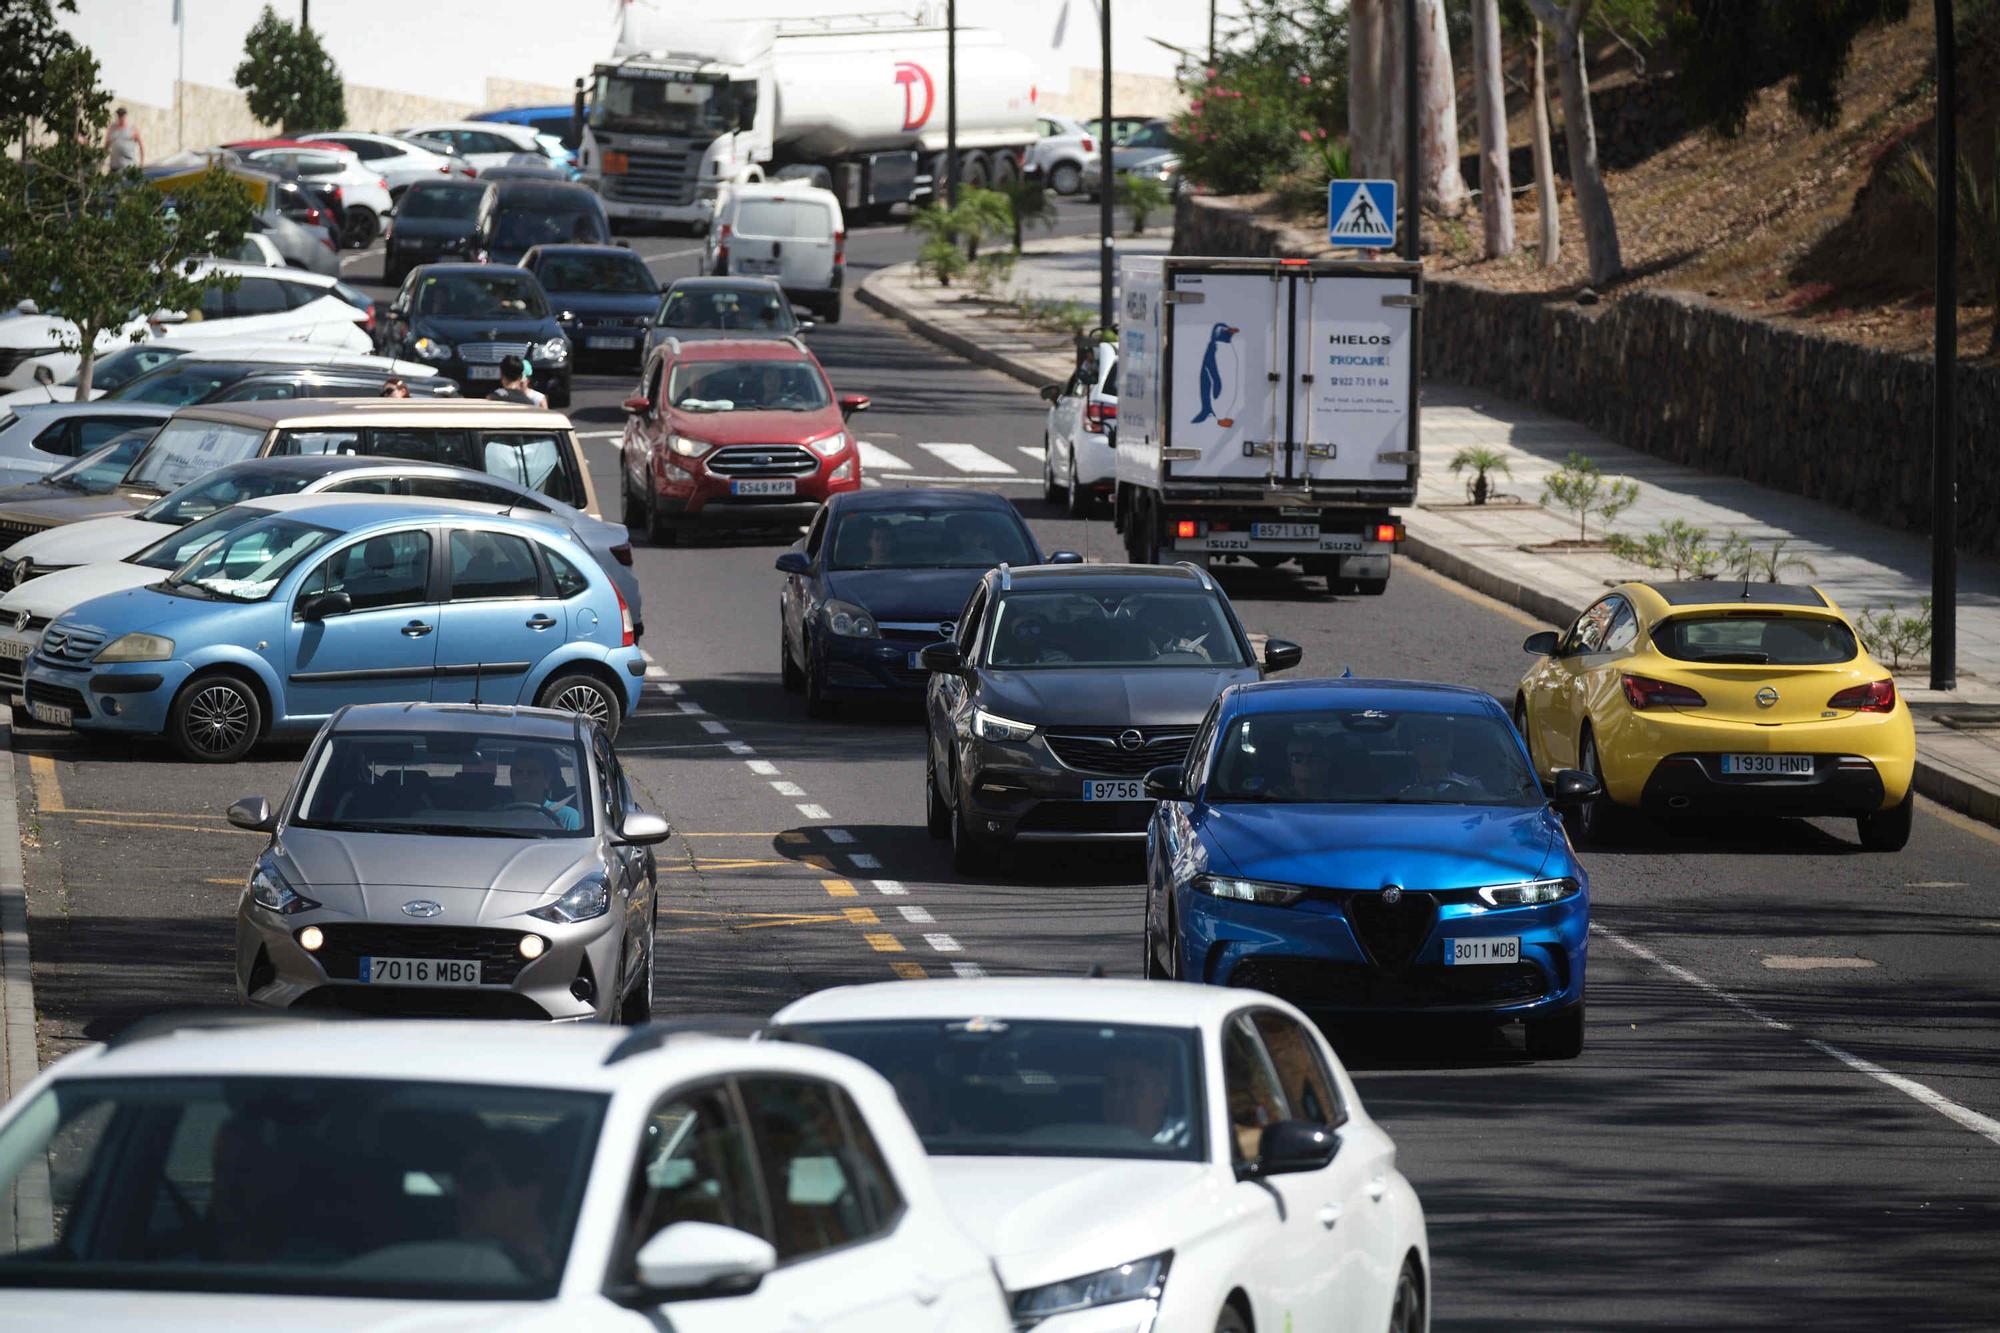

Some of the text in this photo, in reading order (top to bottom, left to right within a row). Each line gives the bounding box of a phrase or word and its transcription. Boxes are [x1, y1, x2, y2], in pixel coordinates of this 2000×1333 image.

[1329, 335, 1391, 345] HIELOS
[1260, 524, 1316, 537] 8571 LXT
[1206, 540, 1249, 549] ISUZU
[1319, 541, 1363, 550] ISUZU
[1735, 757, 1810, 772] 1930 HND
[1095, 783, 1138, 798] 9756
[1455, 942, 1516, 959] 3011 MDB
[376, 961, 475, 981] 7016 MBG
